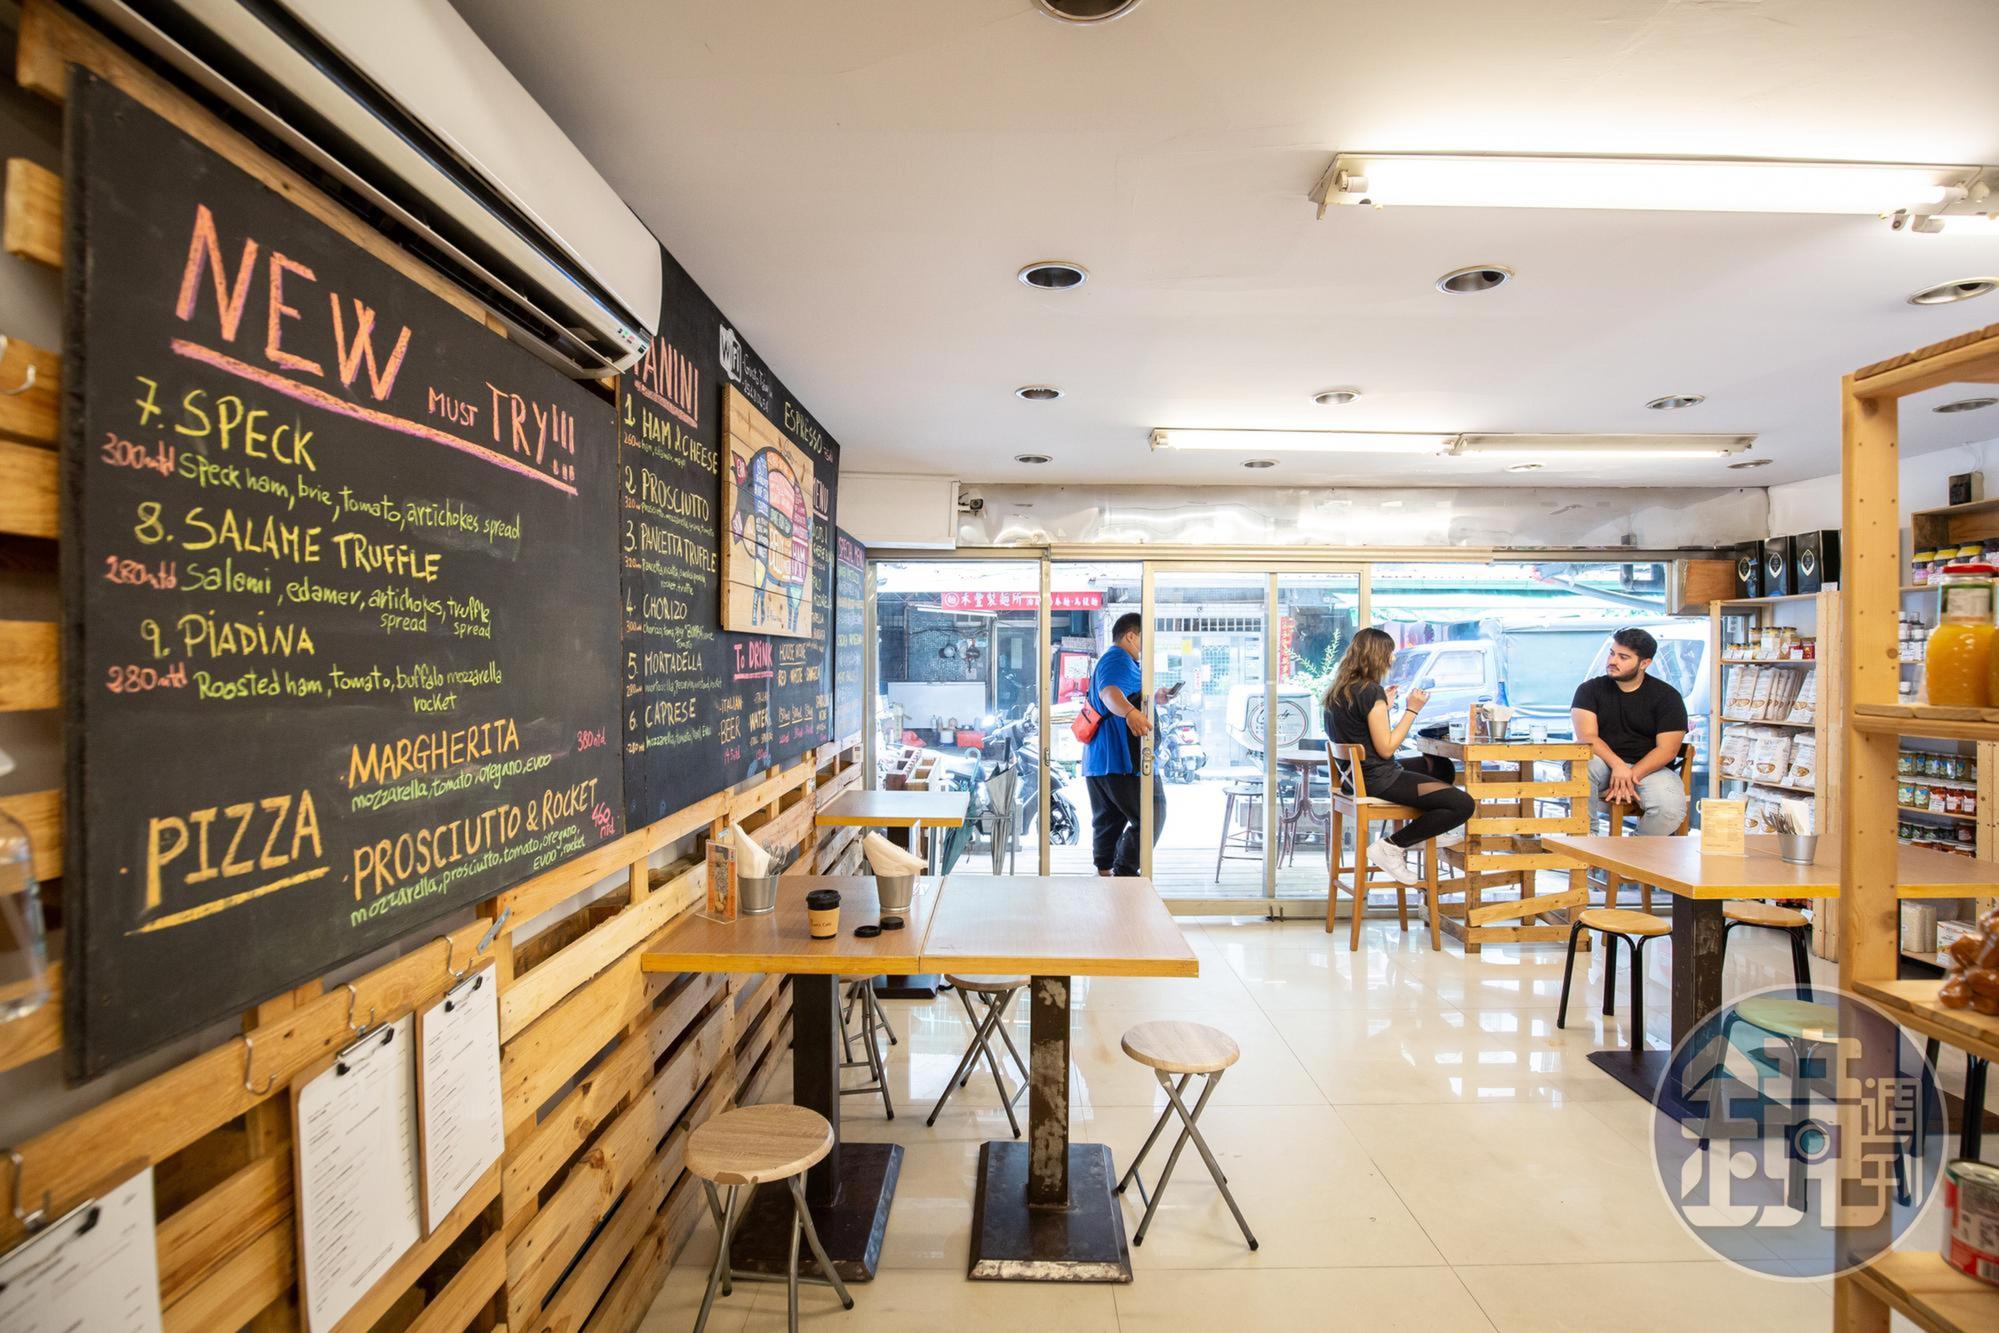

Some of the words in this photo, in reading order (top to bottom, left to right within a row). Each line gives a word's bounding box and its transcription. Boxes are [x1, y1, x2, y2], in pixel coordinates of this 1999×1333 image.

[175, 203, 411, 400] NEW
[428, 386, 478, 426] MUST
[485, 381, 575, 481] TRY!!!
[634, 335, 698, 421] ANINI
[136, 376, 165, 428] 7.
[175, 389, 316, 471] SPECK
[642, 406, 671, 449] HAM
[682, 435, 718, 475] CHEESE
[641, 468, 709, 521] PROSCIUTTO
[134, 501, 174, 545] 8.
[182, 507, 322, 563] SALAME
[331, 532, 442, 583] TRUFFLE
[406, 498, 478, 533] artichokes
[483, 513, 520, 544] spread
[624, 520, 637, 552] 3.
[641, 522, 682, 557] PANCETTA
[684, 538, 717, 573] TRUFFLE
[380, 612, 427, 635] spread
[453, 620, 491, 640] spread
[447, 596, 490, 623] truffle
[643, 594, 687, 620] CHORIZO
[396, 663, 443, 689] buffalo
[447, 660, 502, 686] mozzarella
[644, 651, 703, 676] MORTADELLA
[734, 643, 745, 672] To
[413, 692, 458, 713] rocket
[645, 697, 696, 728] CAPRESE
[348, 718, 520, 789] MARGHERITA
[720, 715, 741, 744] BEER
[146, 789, 322, 909] PIZZA
[353, 804, 521, 901] PROSCIUTTO
[526, 800, 539, 832] &
[542, 778, 598, 830] ROCKET
